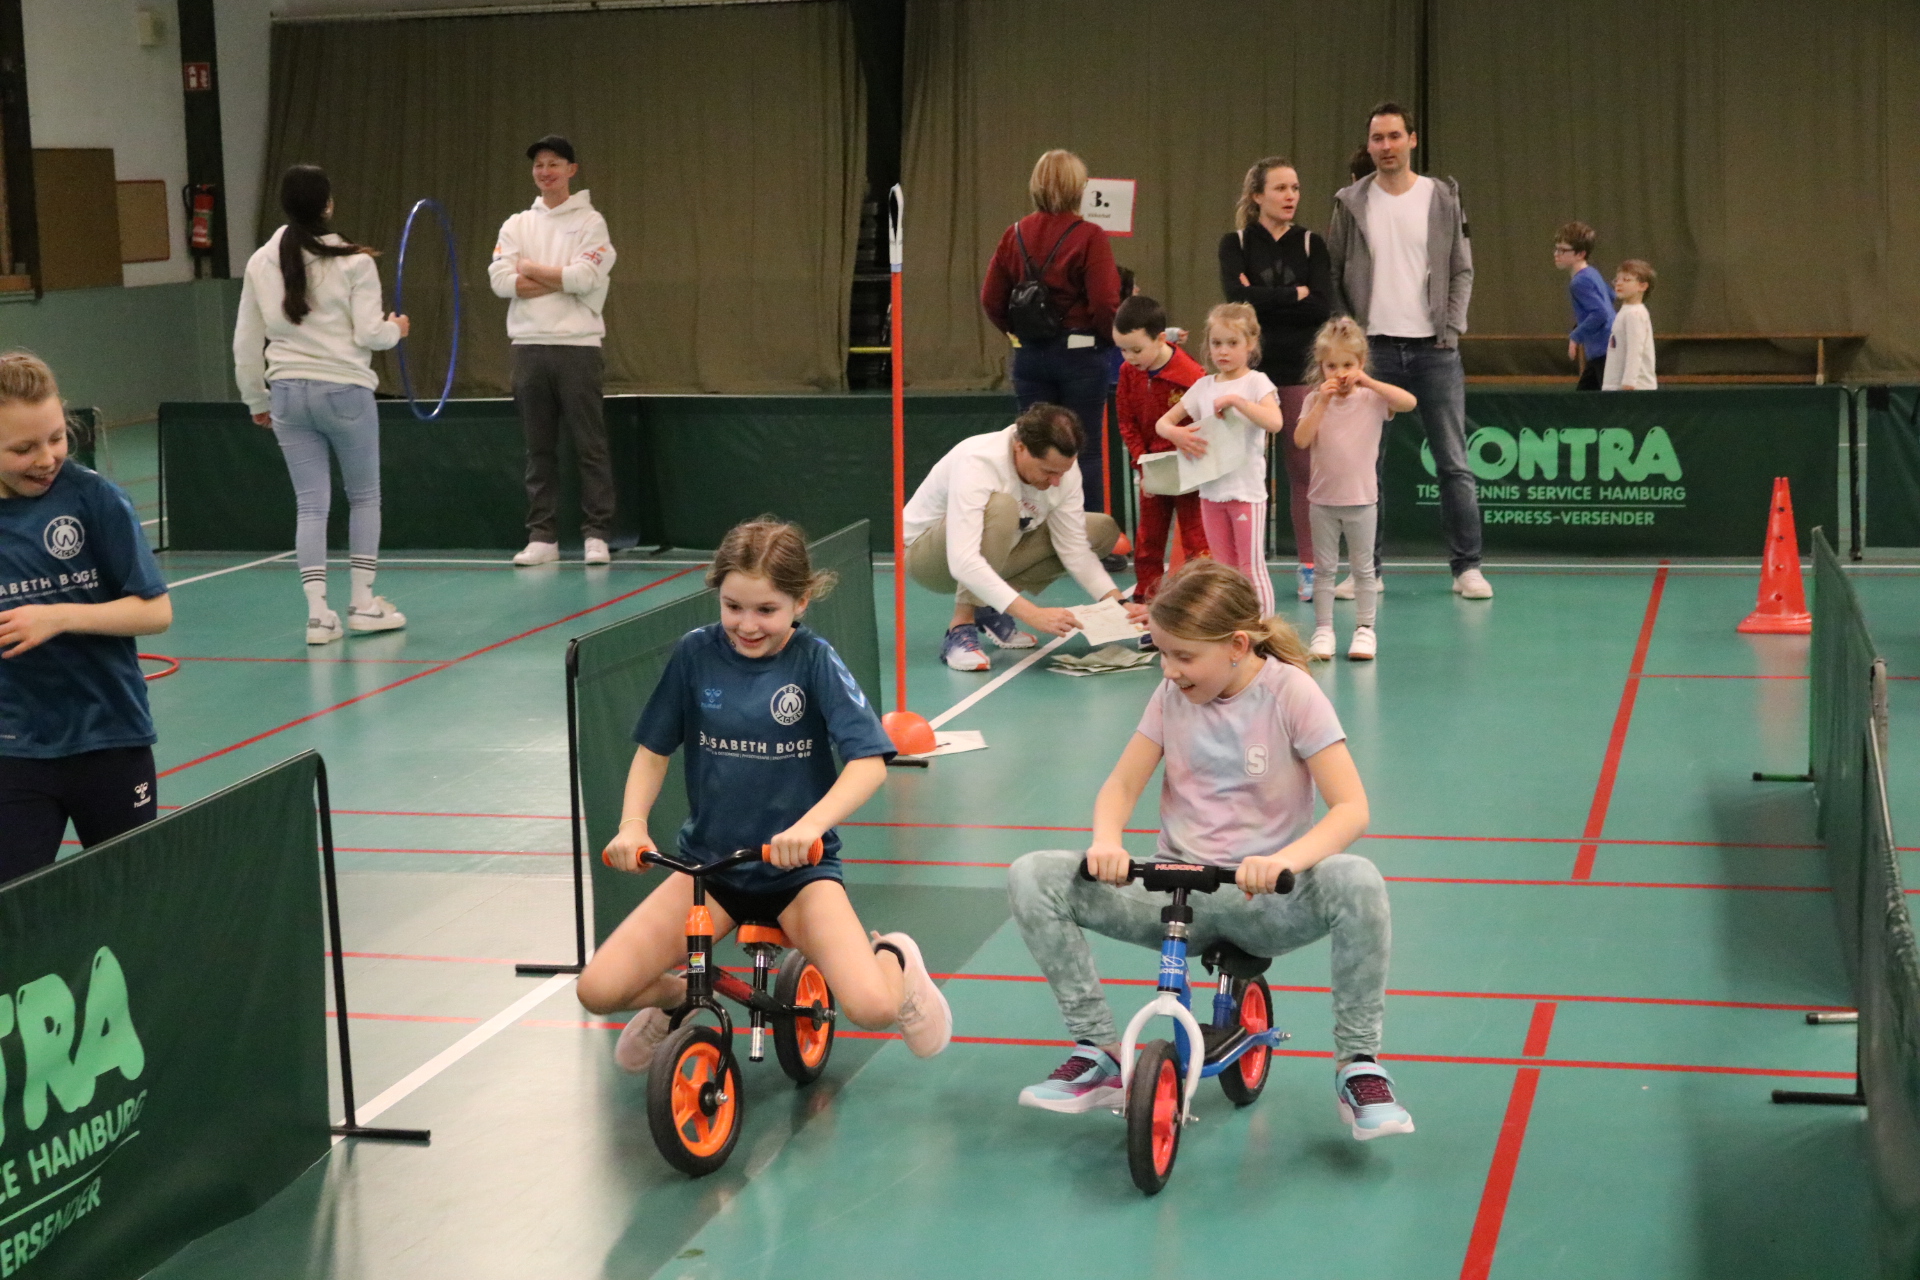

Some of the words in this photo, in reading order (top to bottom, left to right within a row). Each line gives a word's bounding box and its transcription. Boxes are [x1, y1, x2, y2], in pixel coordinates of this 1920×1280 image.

[1090, 190, 1109, 207] 3.
[1527, 486, 1592, 500] SERVICE
[1600, 486, 1686, 501] HAMBURG
[1484, 510, 1655, 525] EXPRESS-VERSENDER
[776, 739, 813, 754] BÖGE
[1246, 745, 1267, 776] S
[1155, 863, 1205, 872] HUDORA
